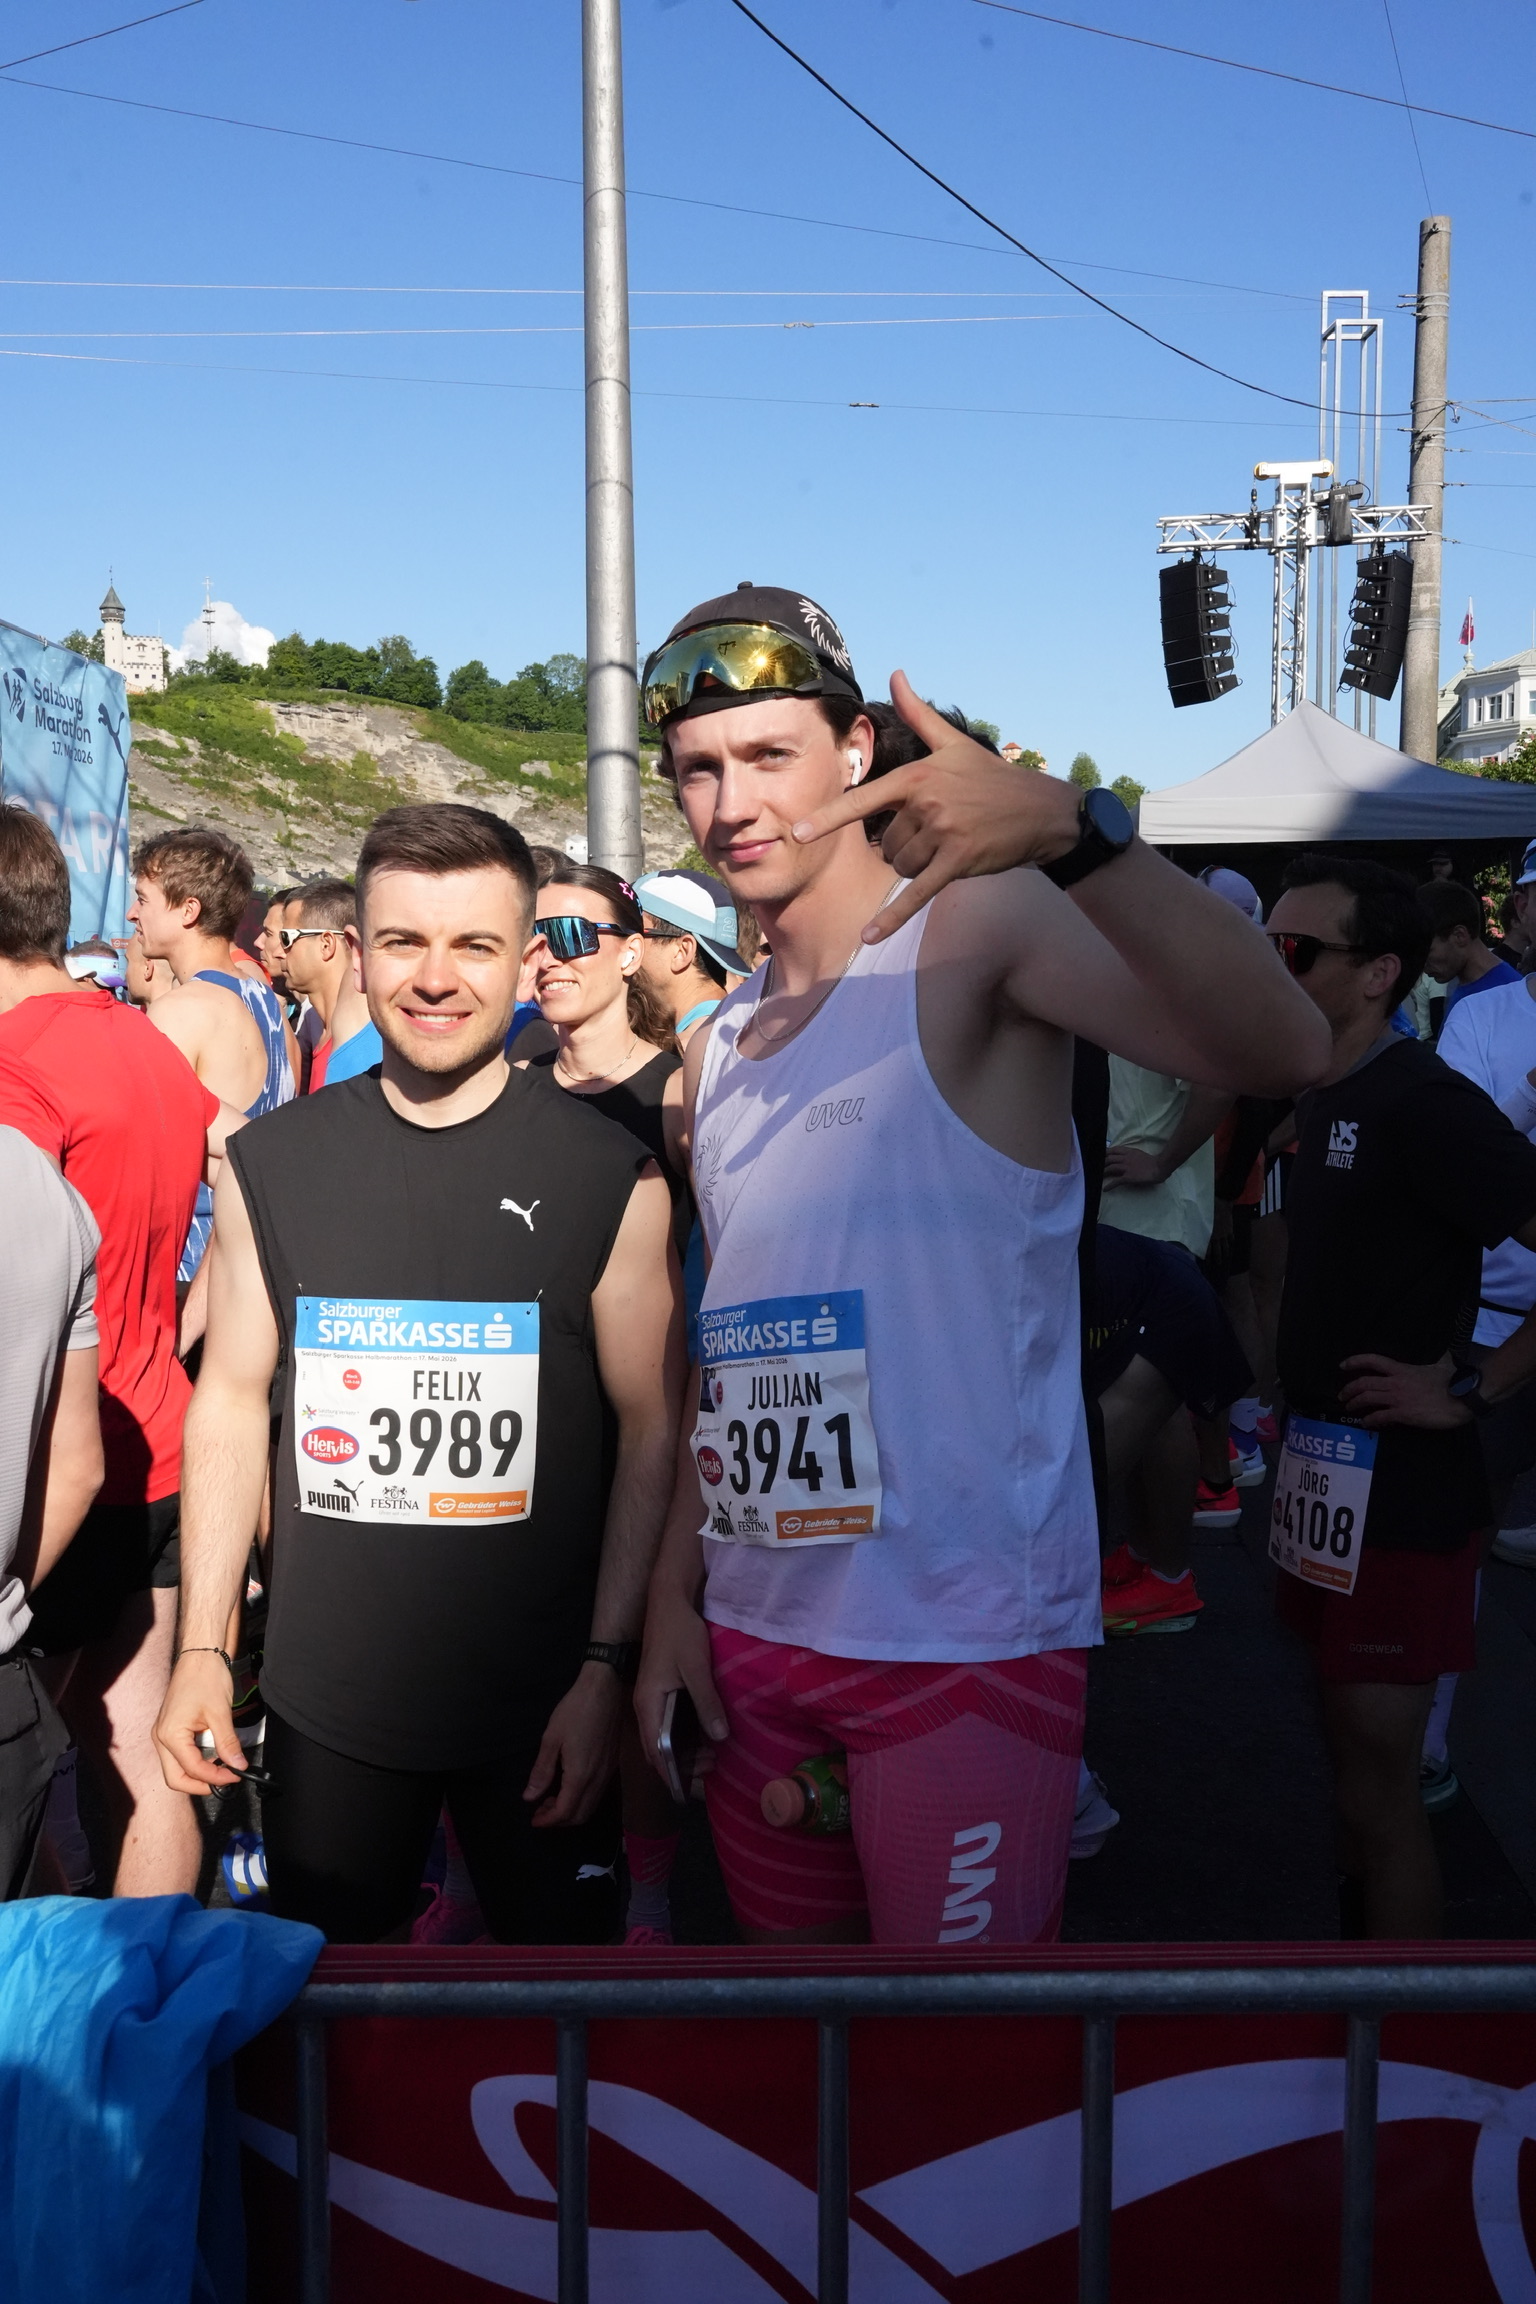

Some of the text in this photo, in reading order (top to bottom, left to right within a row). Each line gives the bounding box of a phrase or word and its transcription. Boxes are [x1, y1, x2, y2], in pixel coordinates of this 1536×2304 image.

[34, 677, 83, 721] Salzburg
[52, 741, 63, 756] 17.
[74, 748, 93, 764] 2026
[1325, 1152, 1354, 1169] ATHLETE
[318, 1302, 402, 1321] Salzburger
[702, 1309, 746, 1330] Salzburger
[317, 1319, 479, 1348] SPARKASSE
[702, 1320, 807, 1358] SPARKASSE
[301, 1350, 332, 1358] Salzburger
[333, 1352, 364, 1361] Sparkasse
[413, 1370, 482, 1402] FELIX
[747, 1371, 822, 1410] JULIAN
[307, 1433, 354, 1457] Hervis
[368, 1407, 522, 1478] 3989
[727, 1412, 856, 1495] 3941
[1298, 1463, 1329, 1497] JÖRG
[307, 1490, 351, 1513] PUMA
[371, 1499, 420, 1510] FESTINA
[457, 1499, 522, 1509] Gebrüder Weiss
[738, 1520, 769, 1532] FESTINA
[804, 1518, 840, 1528] Gebrüder
[1283, 1491, 1355, 1558] 4108
[1349, 1643, 1404, 1654] GOREWEAR
[938, 1821, 1002, 1943] UVU
